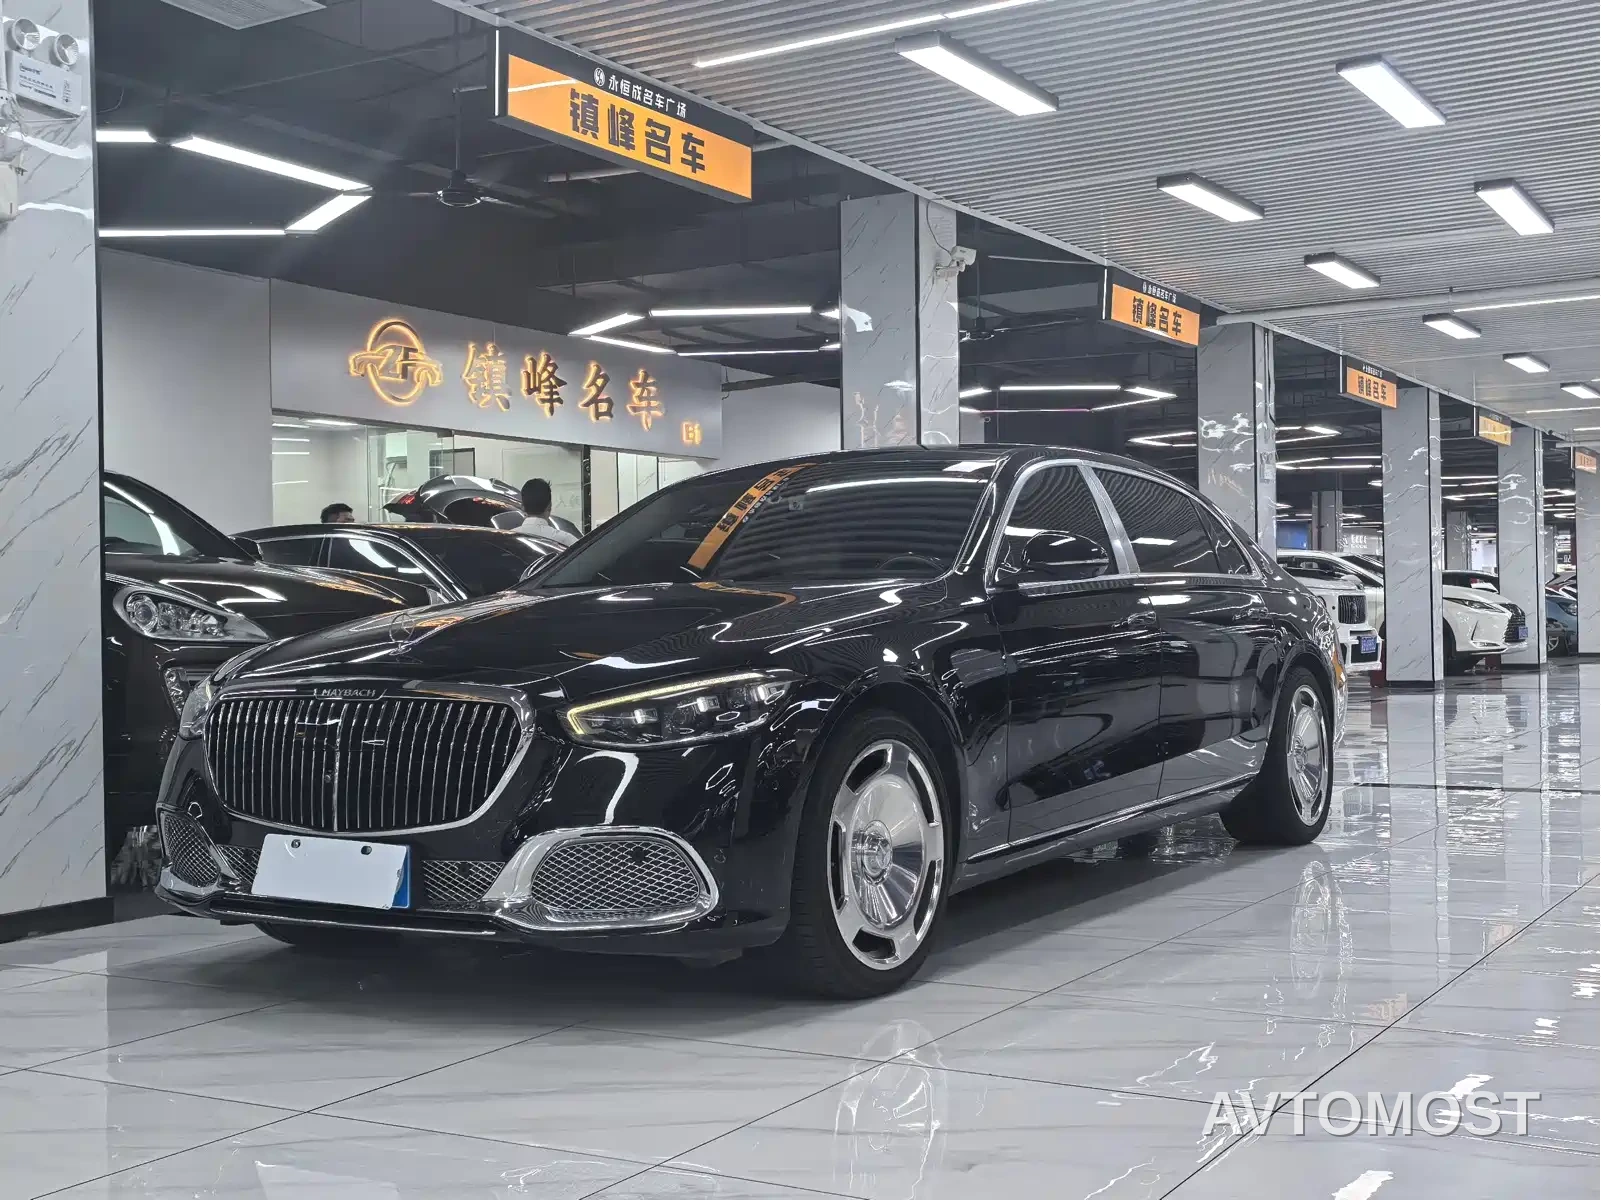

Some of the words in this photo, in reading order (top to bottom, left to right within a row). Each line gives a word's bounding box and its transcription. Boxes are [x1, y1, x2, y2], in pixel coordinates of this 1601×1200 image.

[608, 74, 688, 119] 永恒成名车广场
[569, 87, 706, 174] 镇峰名车
[1132, 295, 1182, 336] 镇峰名车
[460, 342, 665, 432] 镇峰名车
[321, 688, 376, 697] MAYBACH
